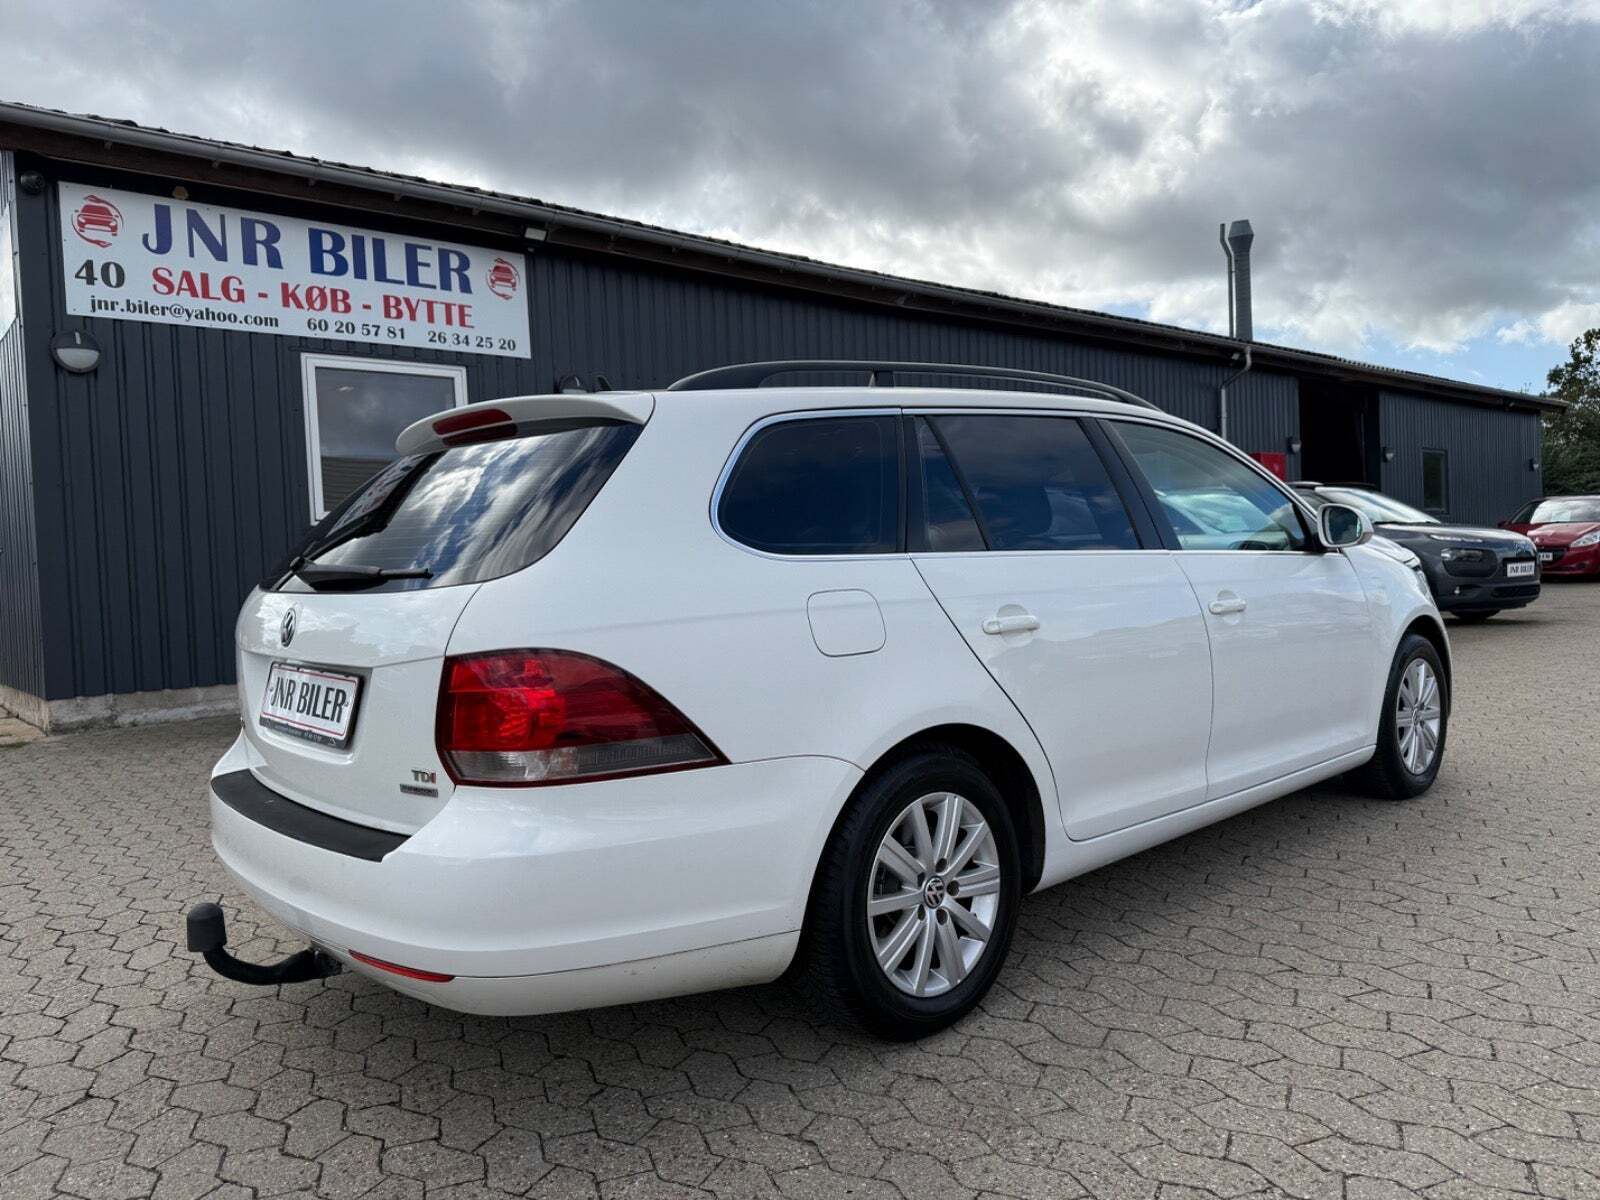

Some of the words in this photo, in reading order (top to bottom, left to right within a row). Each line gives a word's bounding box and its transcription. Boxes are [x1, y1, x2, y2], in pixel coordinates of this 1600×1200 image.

[142, 204, 284, 270] JNR
[308, 227, 473, 294] BILER
[74, 260, 125, 289] 40
[90, 295, 279, 328] jnr.biler@yahoo.com
[152, 267, 245, 303] SALG
[281, 283, 352, 314] KØB
[383, 295, 475, 329] BYTTE
[307, 318, 329, 333] 60
[334, 320, 356, 336] 20
[361, 323, 381, 339] 57
[386, 325, 406, 340] 81
[428, 330, 447, 344] 26
[452, 332, 471, 348] 34
[475, 335, 494, 350] 25
[499, 337, 516, 352] 20
[271, 676, 296, 711] JNR
[297, 682, 346, 723] BILER
[411, 770, 436, 783] TDI
